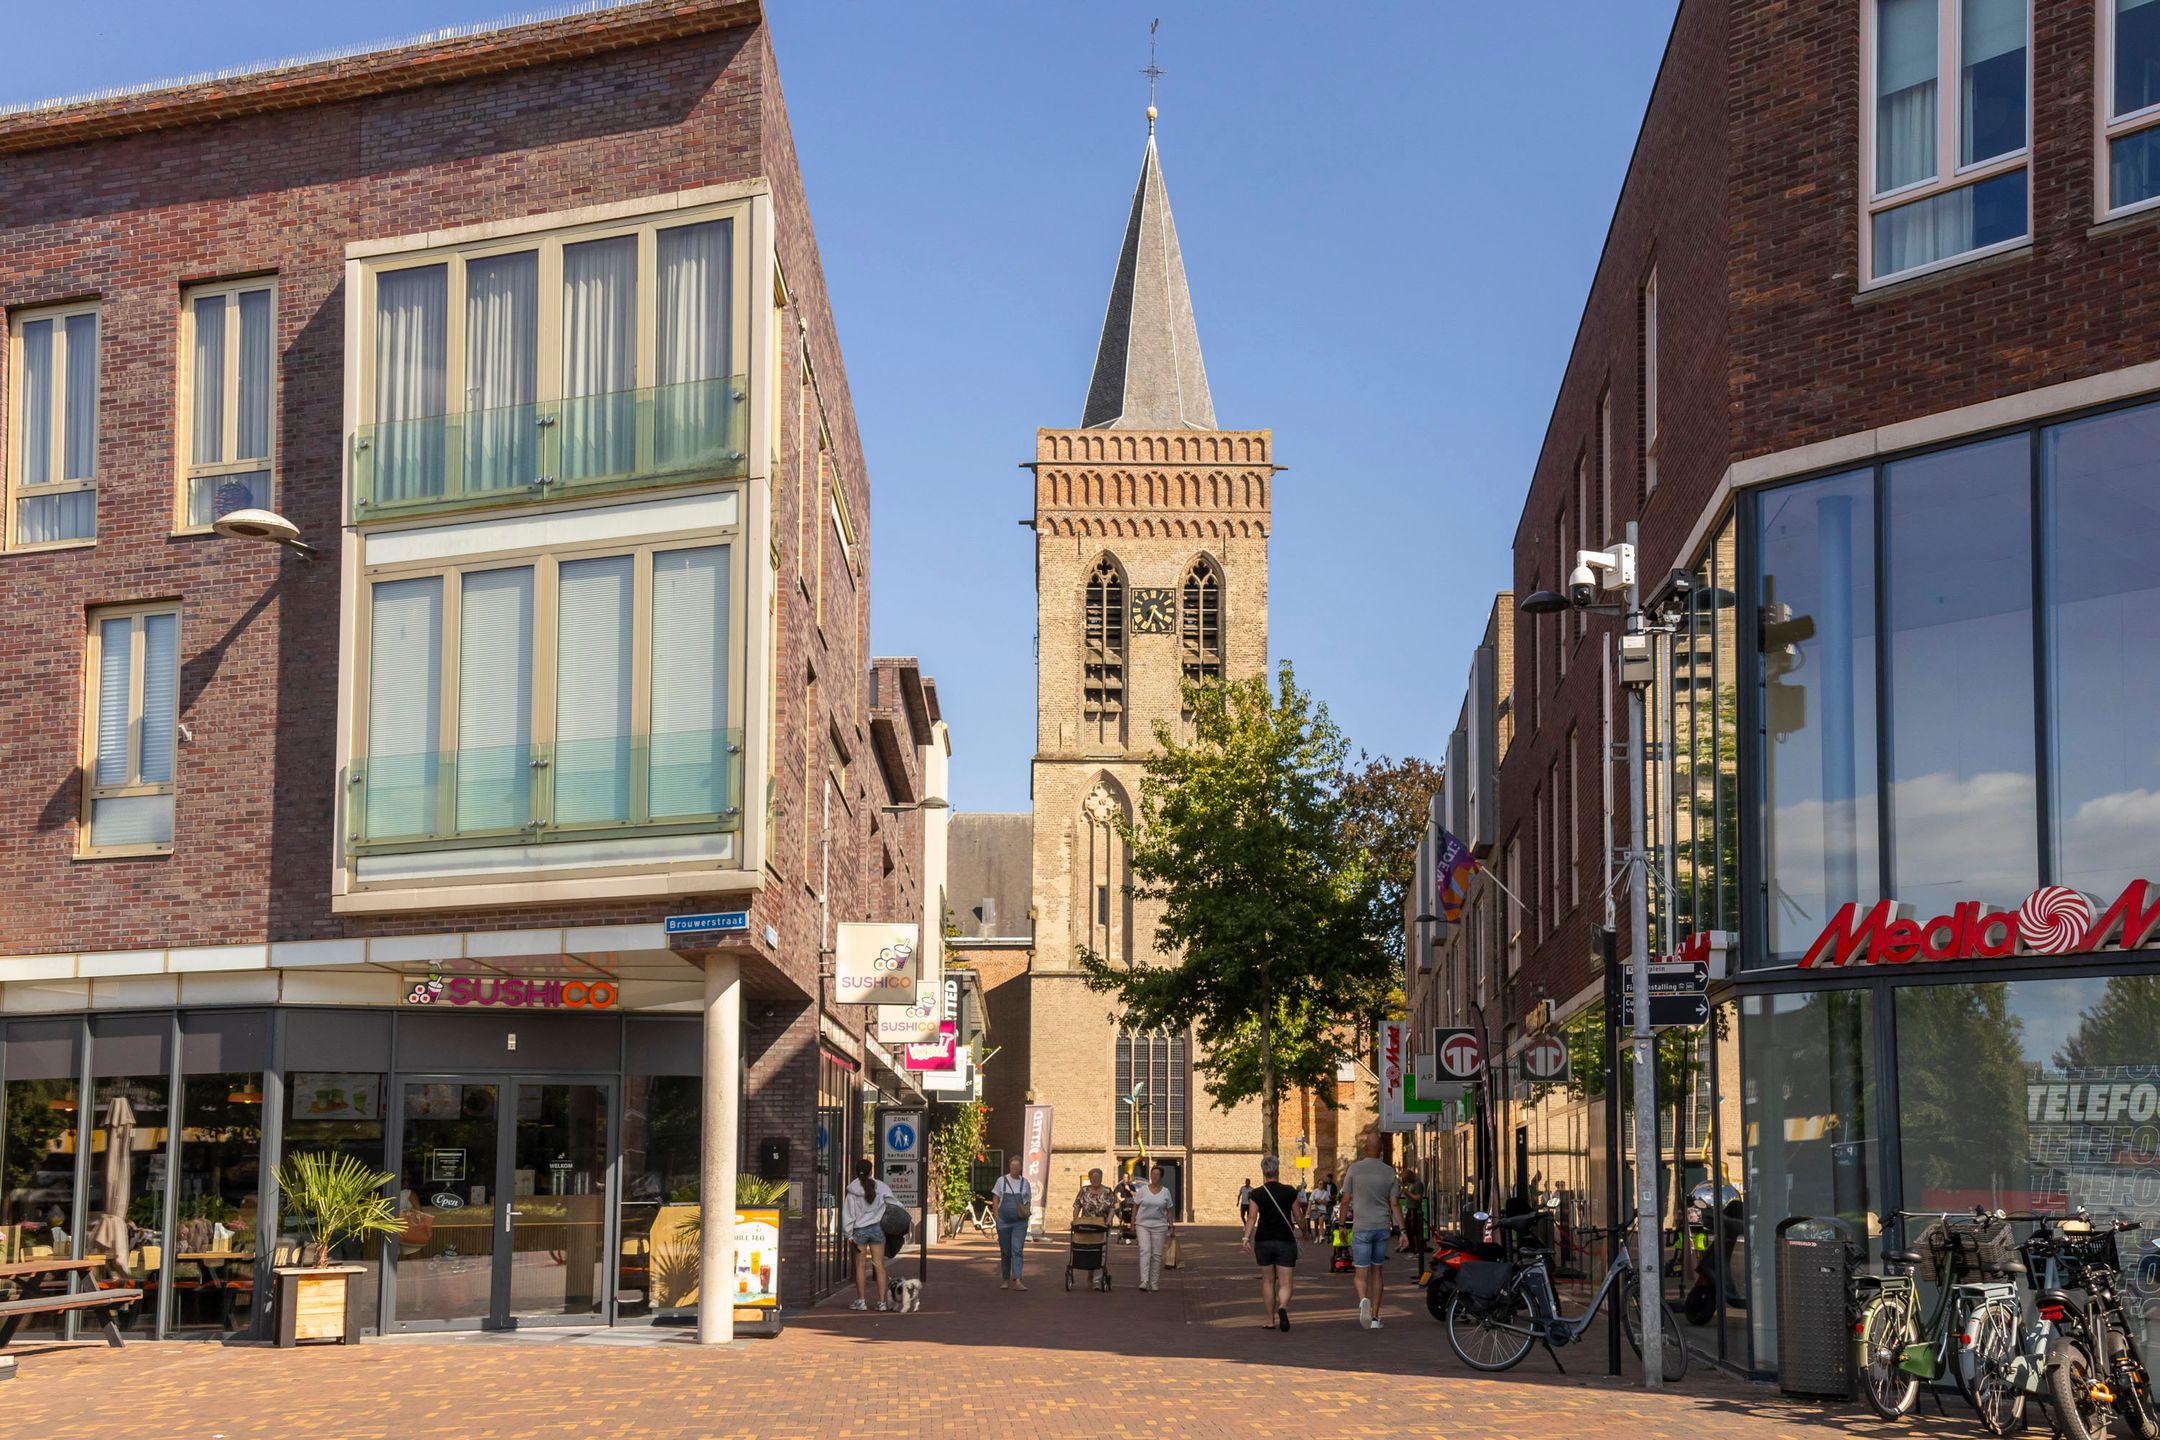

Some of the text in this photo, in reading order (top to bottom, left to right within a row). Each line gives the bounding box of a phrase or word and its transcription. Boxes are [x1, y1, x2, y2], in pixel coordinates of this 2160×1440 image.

[669, 917, 743, 929] Brouwerstraat
[1797, 899, 2020, 968] Media
[448, 977, 616, 1009] SUSHICO
[841, 976, 911, 989] SUSHICO
[880, 1021, 936, 1032] SUSHICO
[2027, 1084, 2160, 1121] TELEFO
[2029, 1126, 2160, 1164] TELEFO
[436, 1195, 458, 1207] Open
[2031, 1168, 2160, 1207] TELEFO
